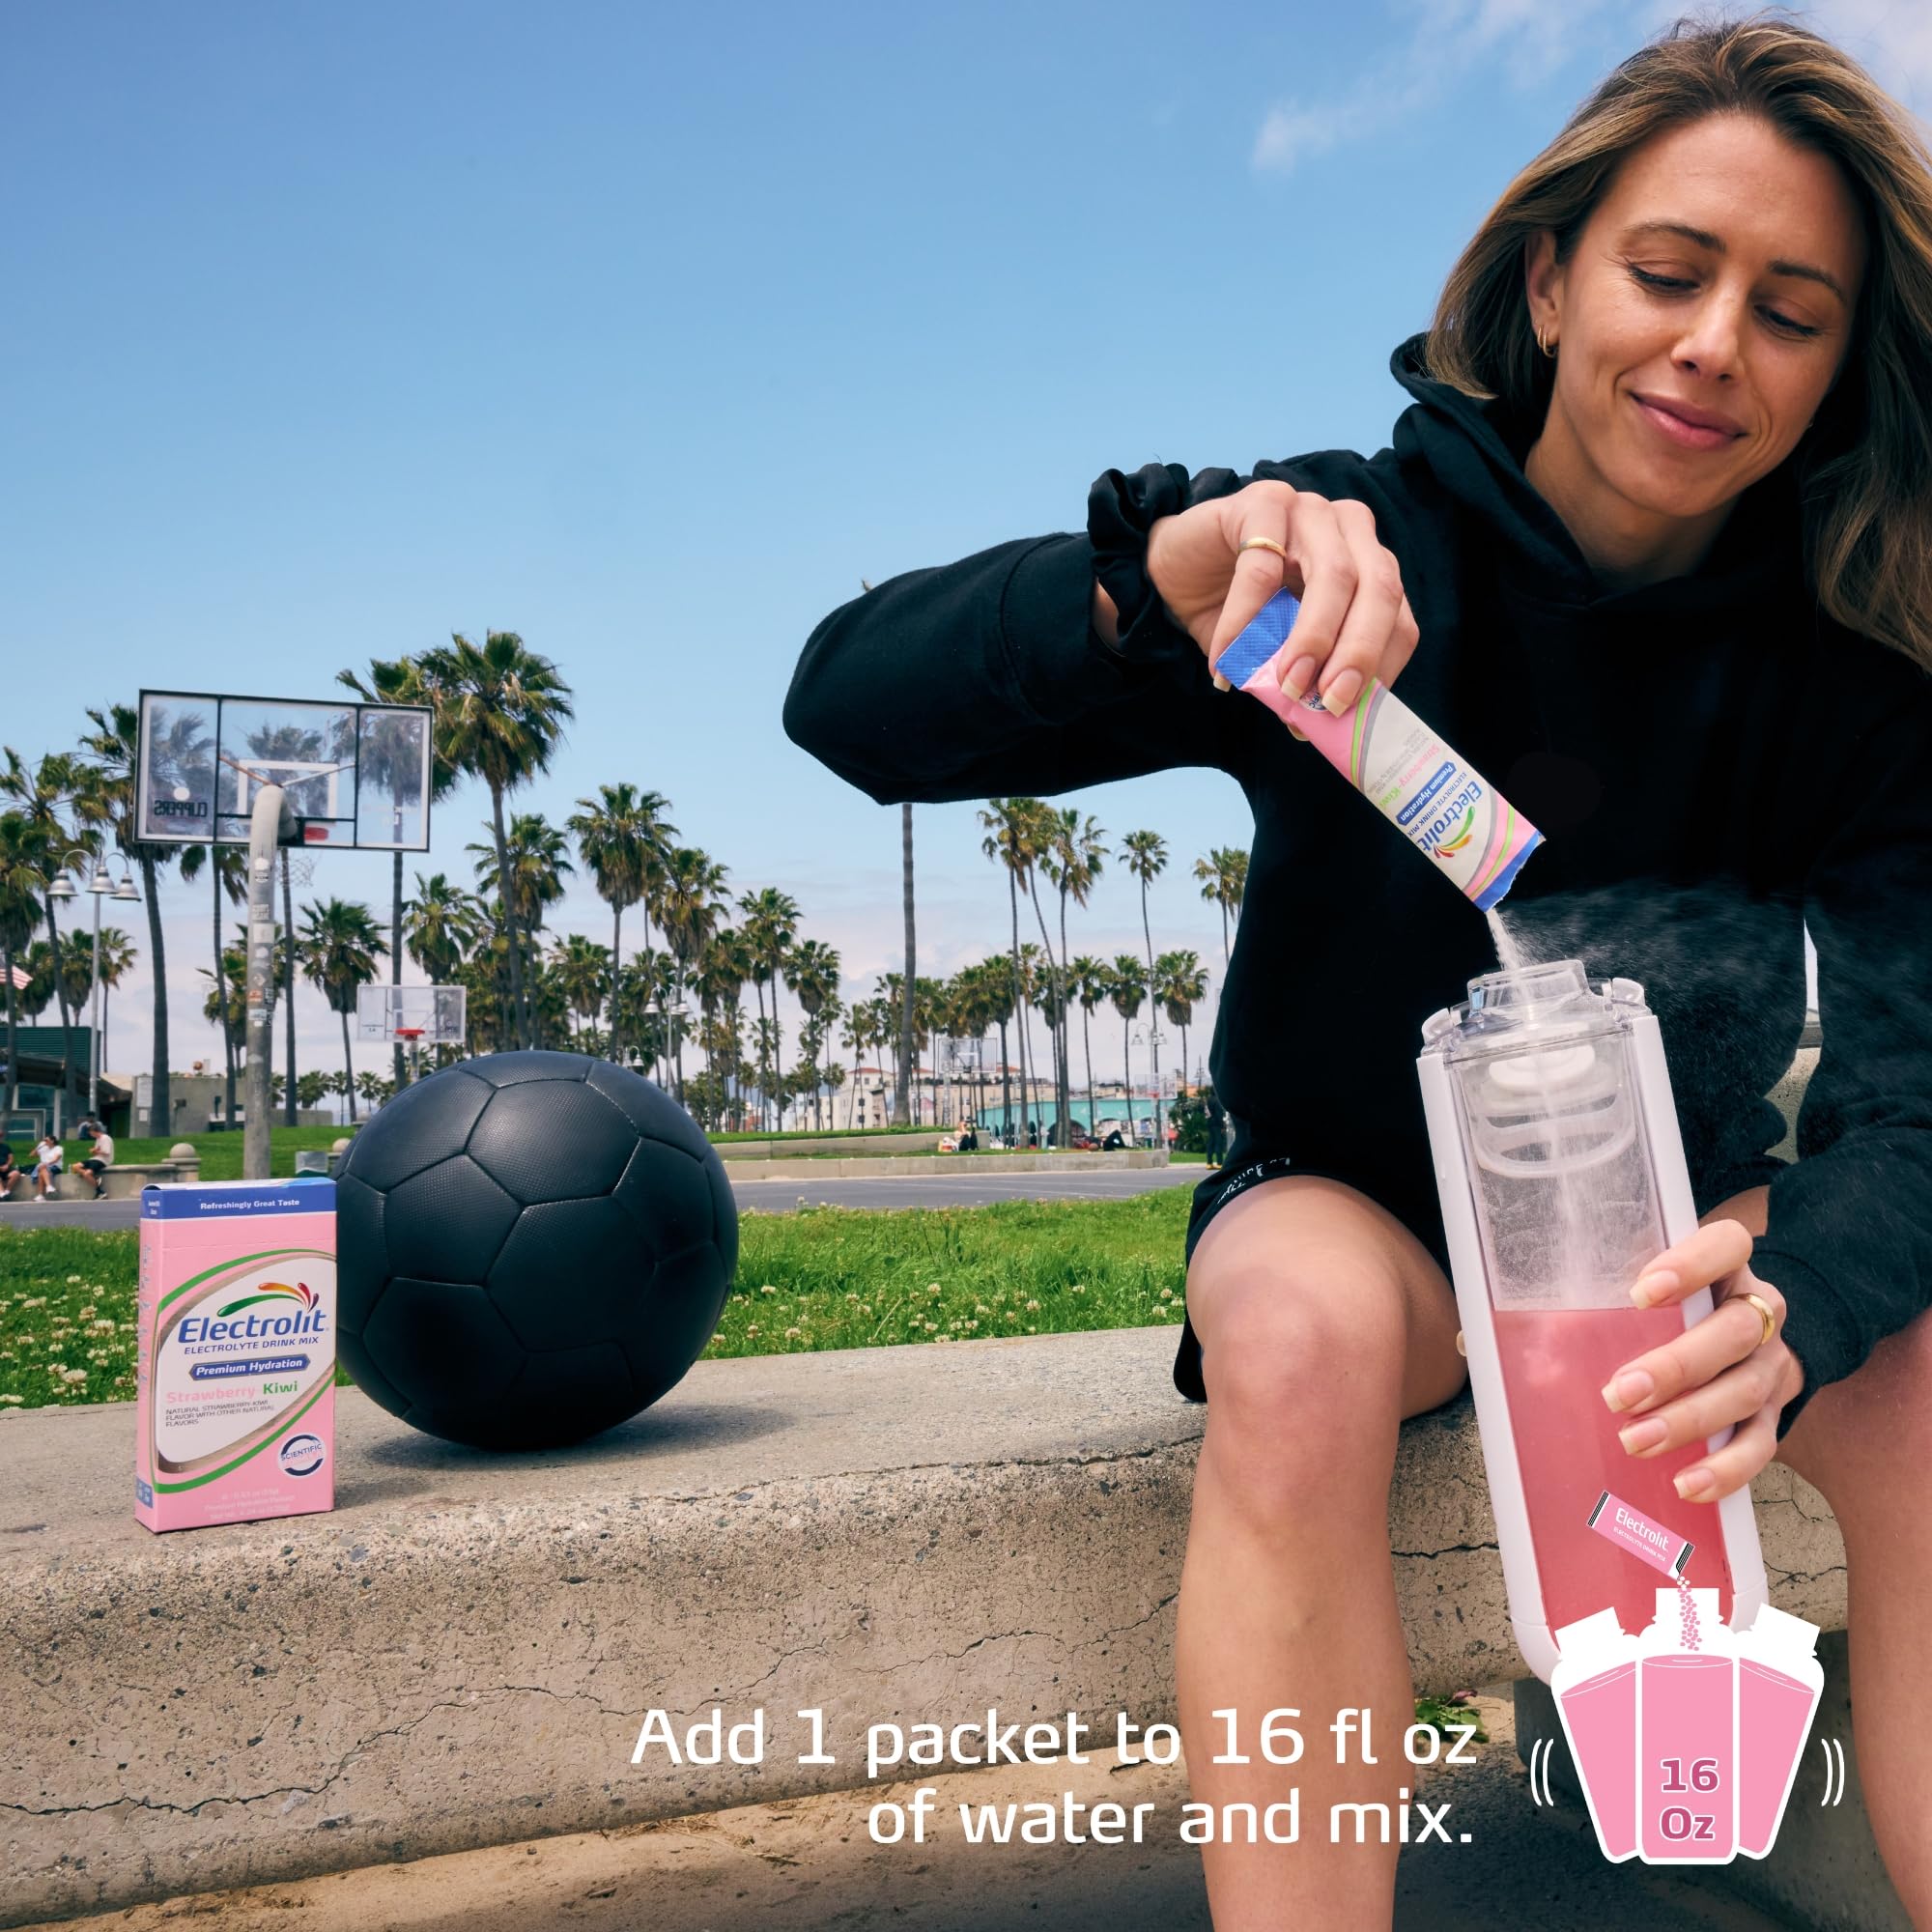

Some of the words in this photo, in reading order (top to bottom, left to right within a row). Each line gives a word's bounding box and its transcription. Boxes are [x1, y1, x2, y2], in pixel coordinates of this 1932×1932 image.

[1430, 764, 1453, 790] Premium
[1437, 772, 1467, 807] ELECTROLYTE
[1400, 788, 1433, 821] Hydration
[1417, 781, 1483, 851] Electrolit
[1419, 806, 1438, 827] DRINK
[1406, 824, 1420, 838] MIX
[200, 1201, 252, 1209] Refreshingly
[178, 1310, 327, 1344] Electrolit
[184, 1342, 259, 1355] ELECTROLYTE
[262, 1338, 296, 1349] DRINK
[298, 1336, 320, 1345] MIX
[195, 1362, 246, 1377] Premium
[249, 1358, 303, 1372] Hydration
[166, 1384, 256, 1405] Strawberry
[263, 1380, 298, 1395] Kiwi
[165, 1406, 199, 1415] NATURAL
[281, 1443, 323, 1462] SCIENTIFIC
